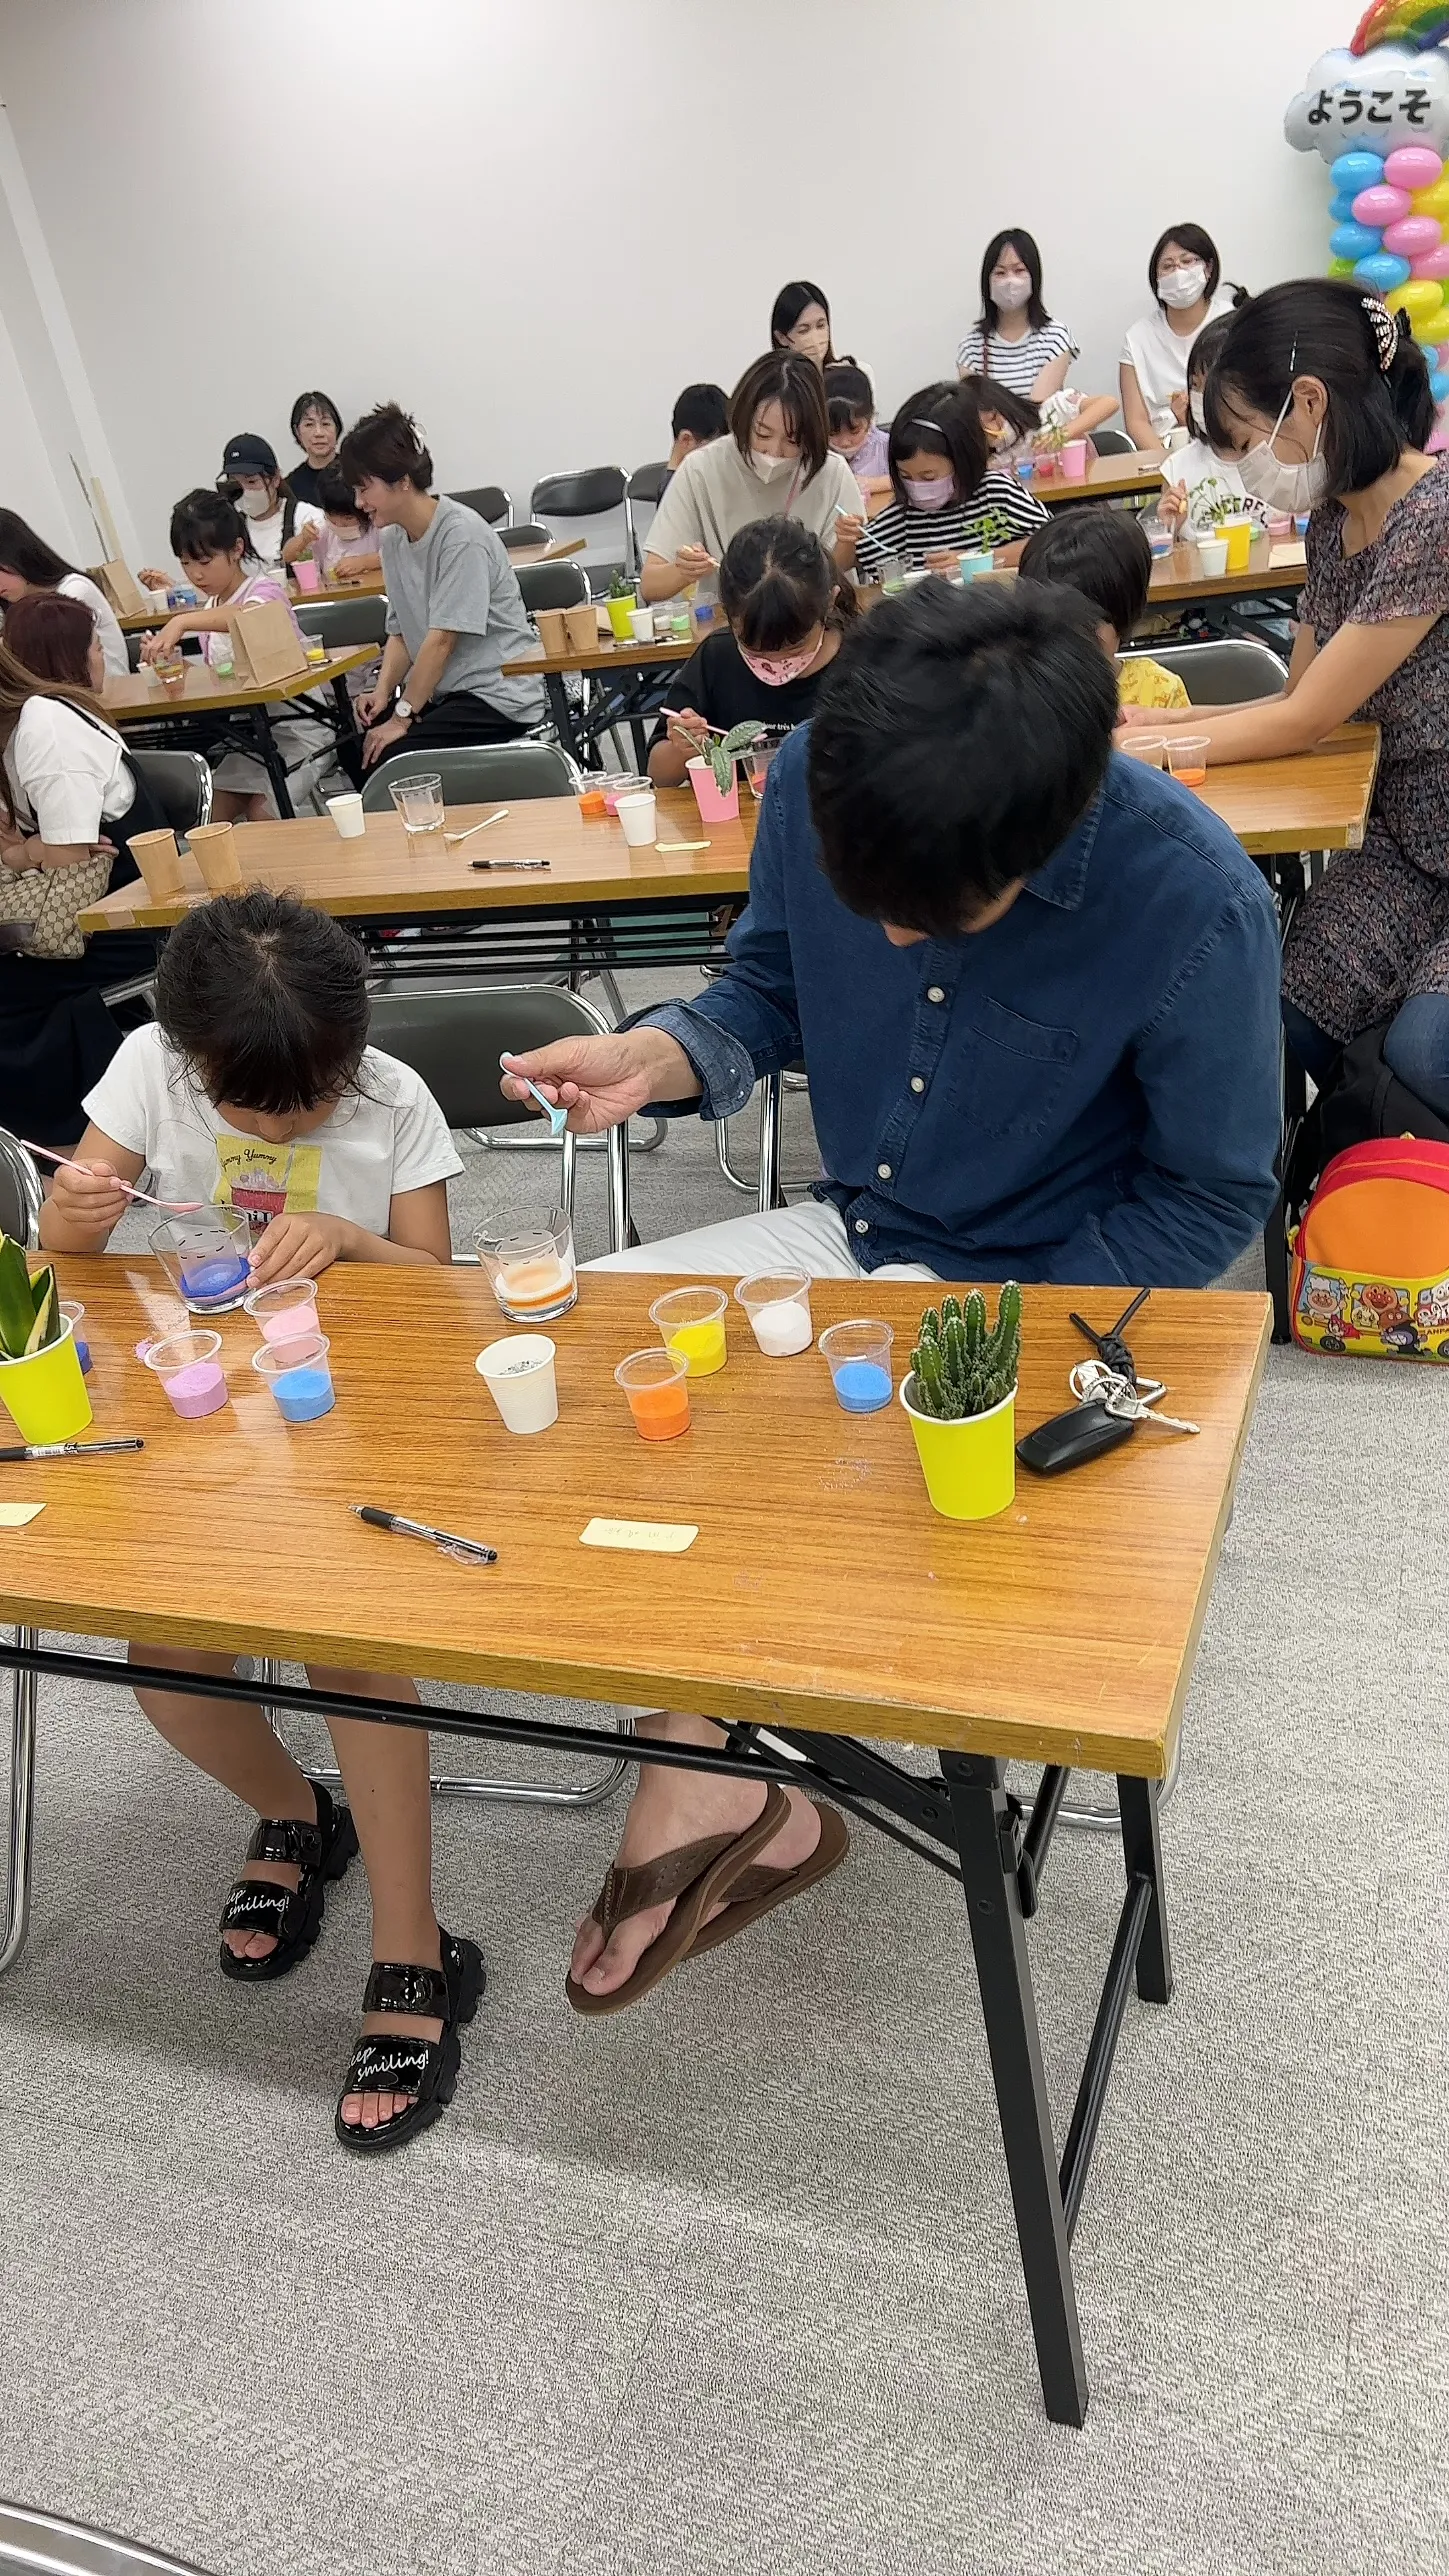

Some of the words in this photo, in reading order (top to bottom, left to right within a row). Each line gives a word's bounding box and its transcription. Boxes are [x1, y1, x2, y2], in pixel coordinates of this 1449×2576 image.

[1308, 88, 1431, 125] ようこそ
[243, 1148, 277, 1165] Yummy
[227, 1895, 290, 1919] smiling!
[357, 2050, 430, 2082] smiling!
